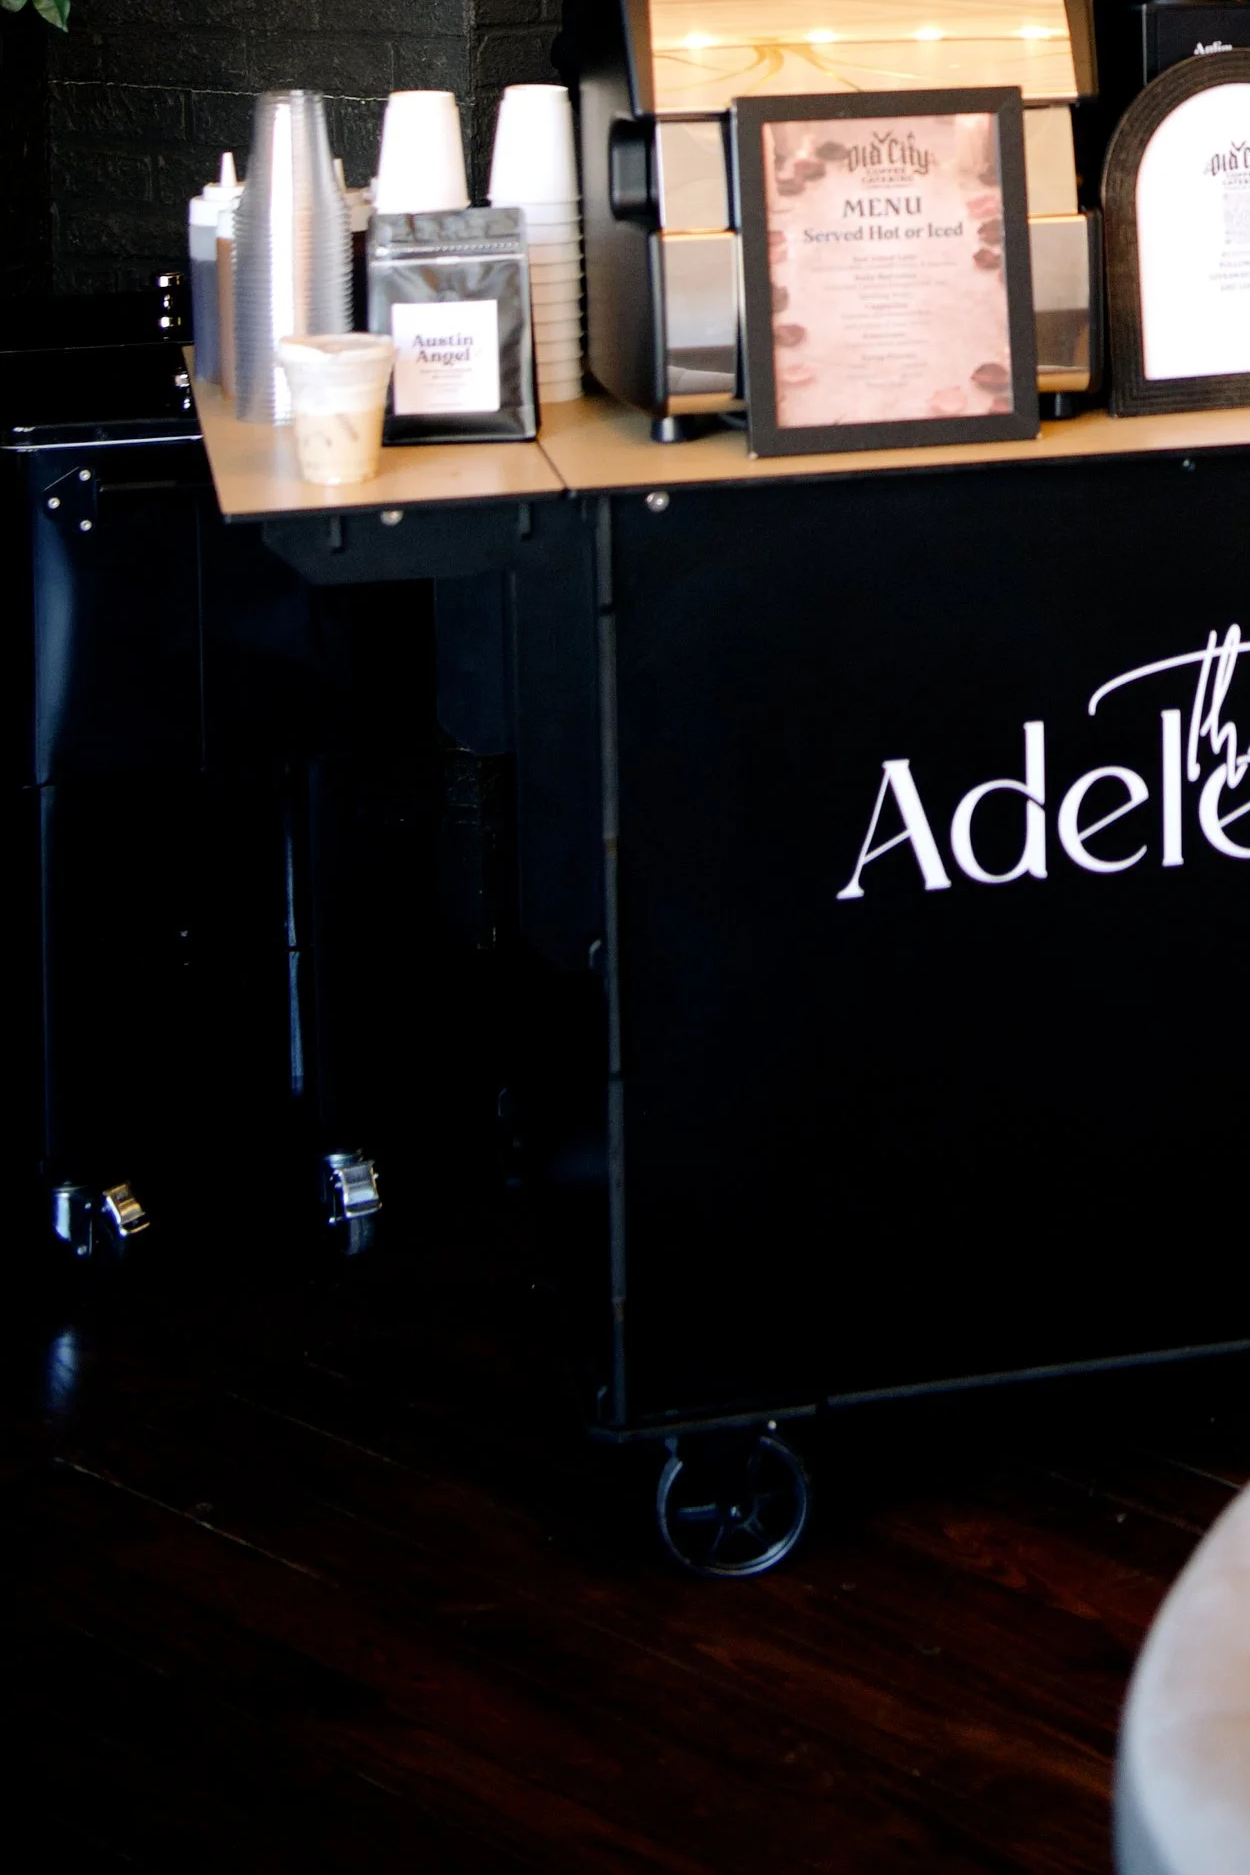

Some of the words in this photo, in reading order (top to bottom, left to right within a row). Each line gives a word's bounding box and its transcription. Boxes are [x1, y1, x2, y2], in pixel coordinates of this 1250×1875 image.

[847, 140, 882, 173] Old
[888, 131, 929, 176] City
[1211, 149, 1239, 177] Old
[843, 196, 922, 218] MENU
[803, 225, 864, 243] Served
[868, 224, 900, 241] Hot
[905, 226, 925, 239] or
[928, 221, 964, 238] Iced
[412, 333, 474, 347] Austin
[415, 347, 471, 366] Angel
